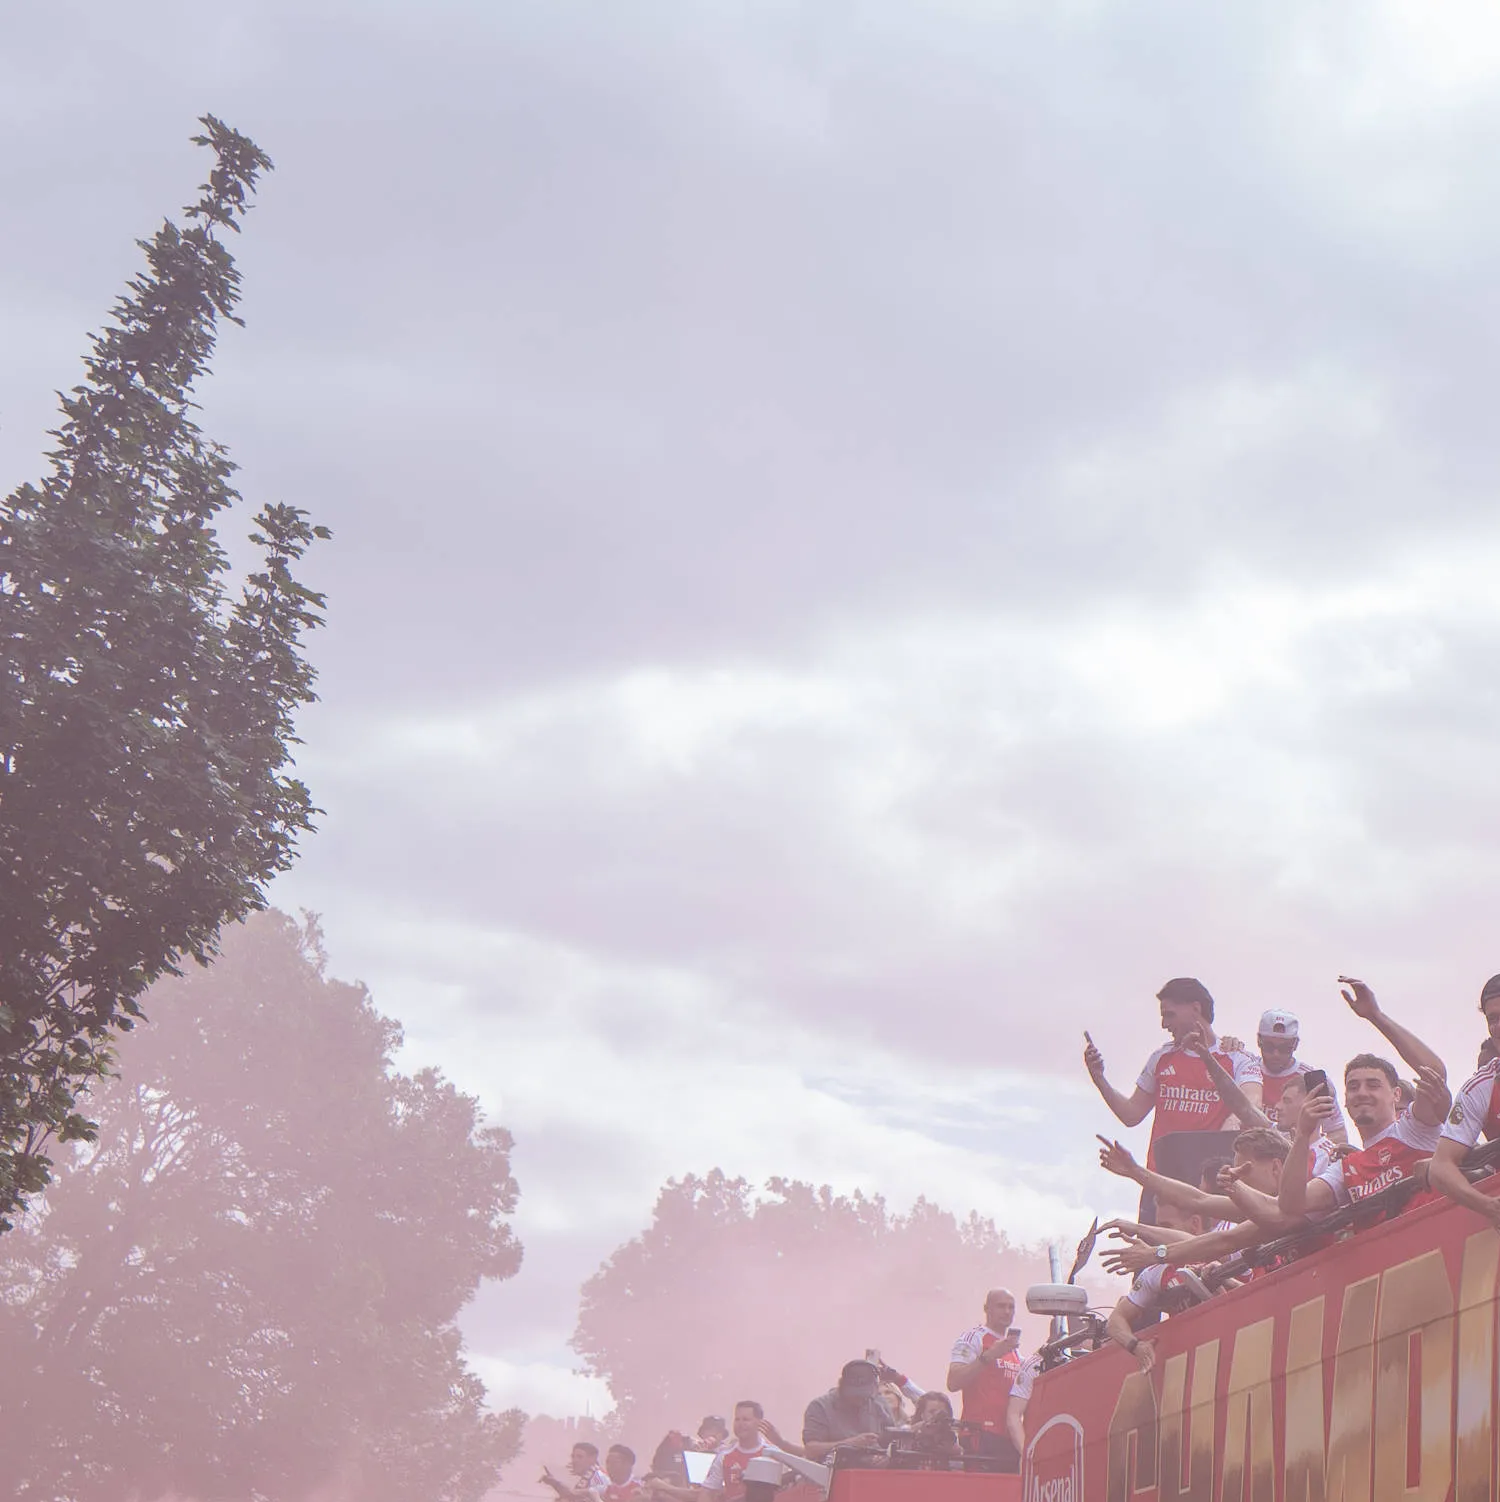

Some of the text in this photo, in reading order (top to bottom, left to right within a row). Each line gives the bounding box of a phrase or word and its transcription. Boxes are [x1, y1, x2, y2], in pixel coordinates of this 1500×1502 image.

[1159, 1084, 1221, 1103] Emirates
[1163, 1099, 1210, 1114] FLY BETTER
